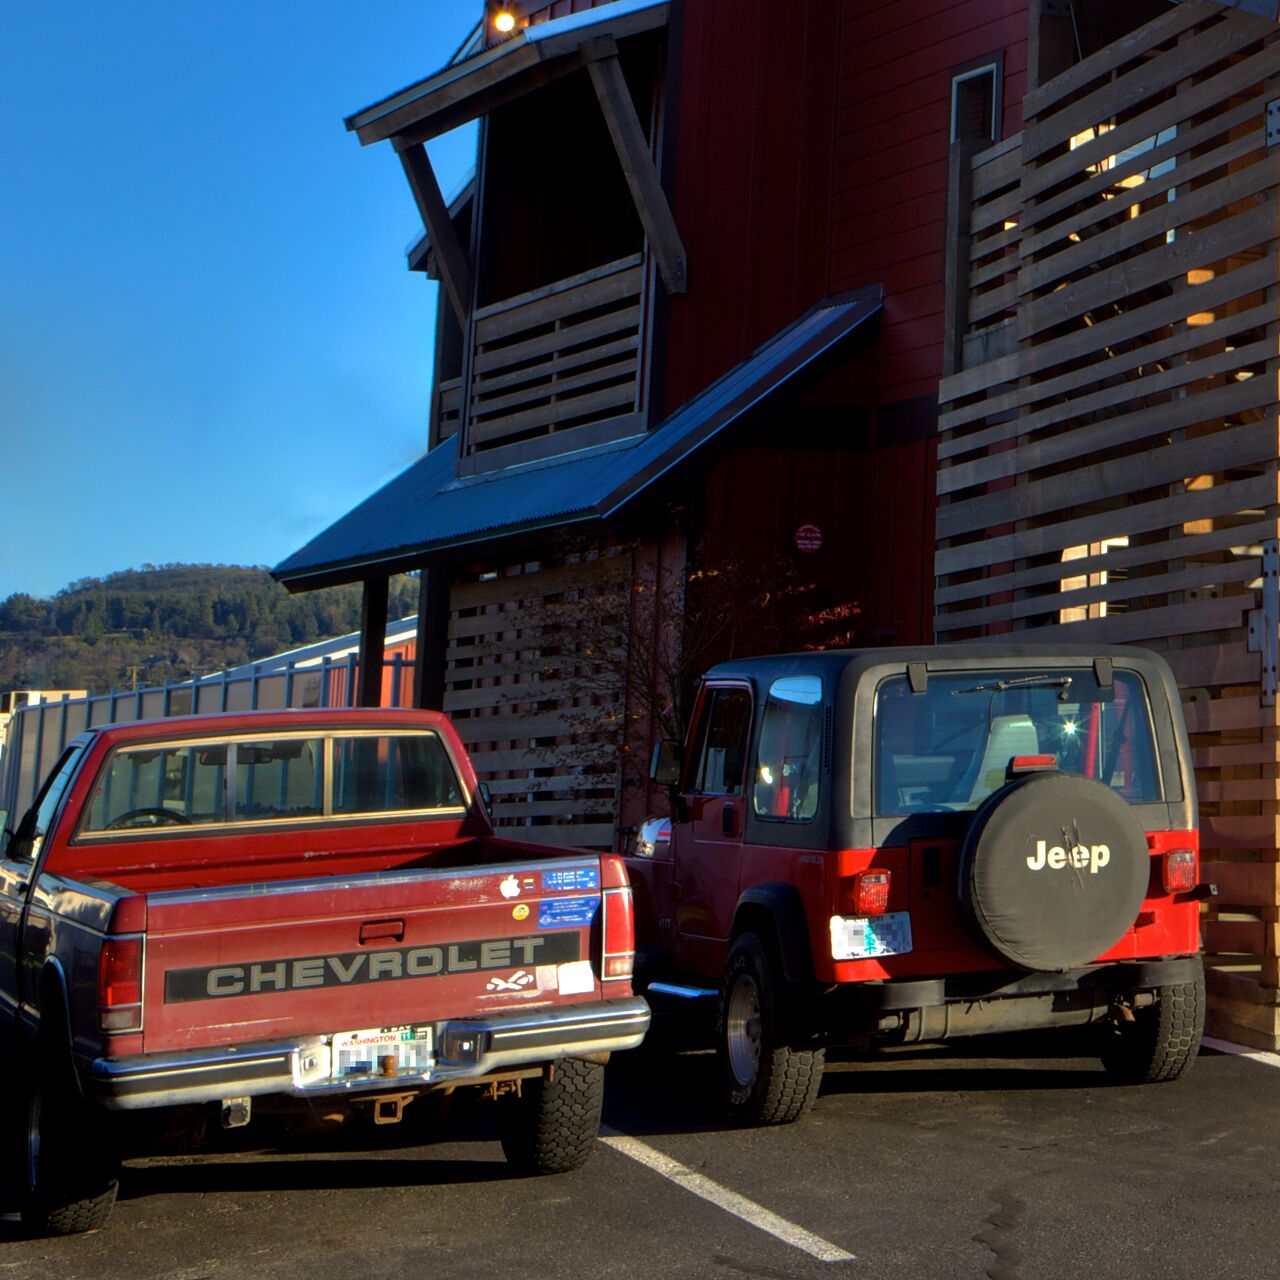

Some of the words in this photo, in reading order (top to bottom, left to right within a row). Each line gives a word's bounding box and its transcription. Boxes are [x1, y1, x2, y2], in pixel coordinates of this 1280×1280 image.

[1026, 840, 1110, 873] Jeep
[206, 937, 544, 996] CHEVROLET
[341, 1034, 397, 1047] WASHINGTON
